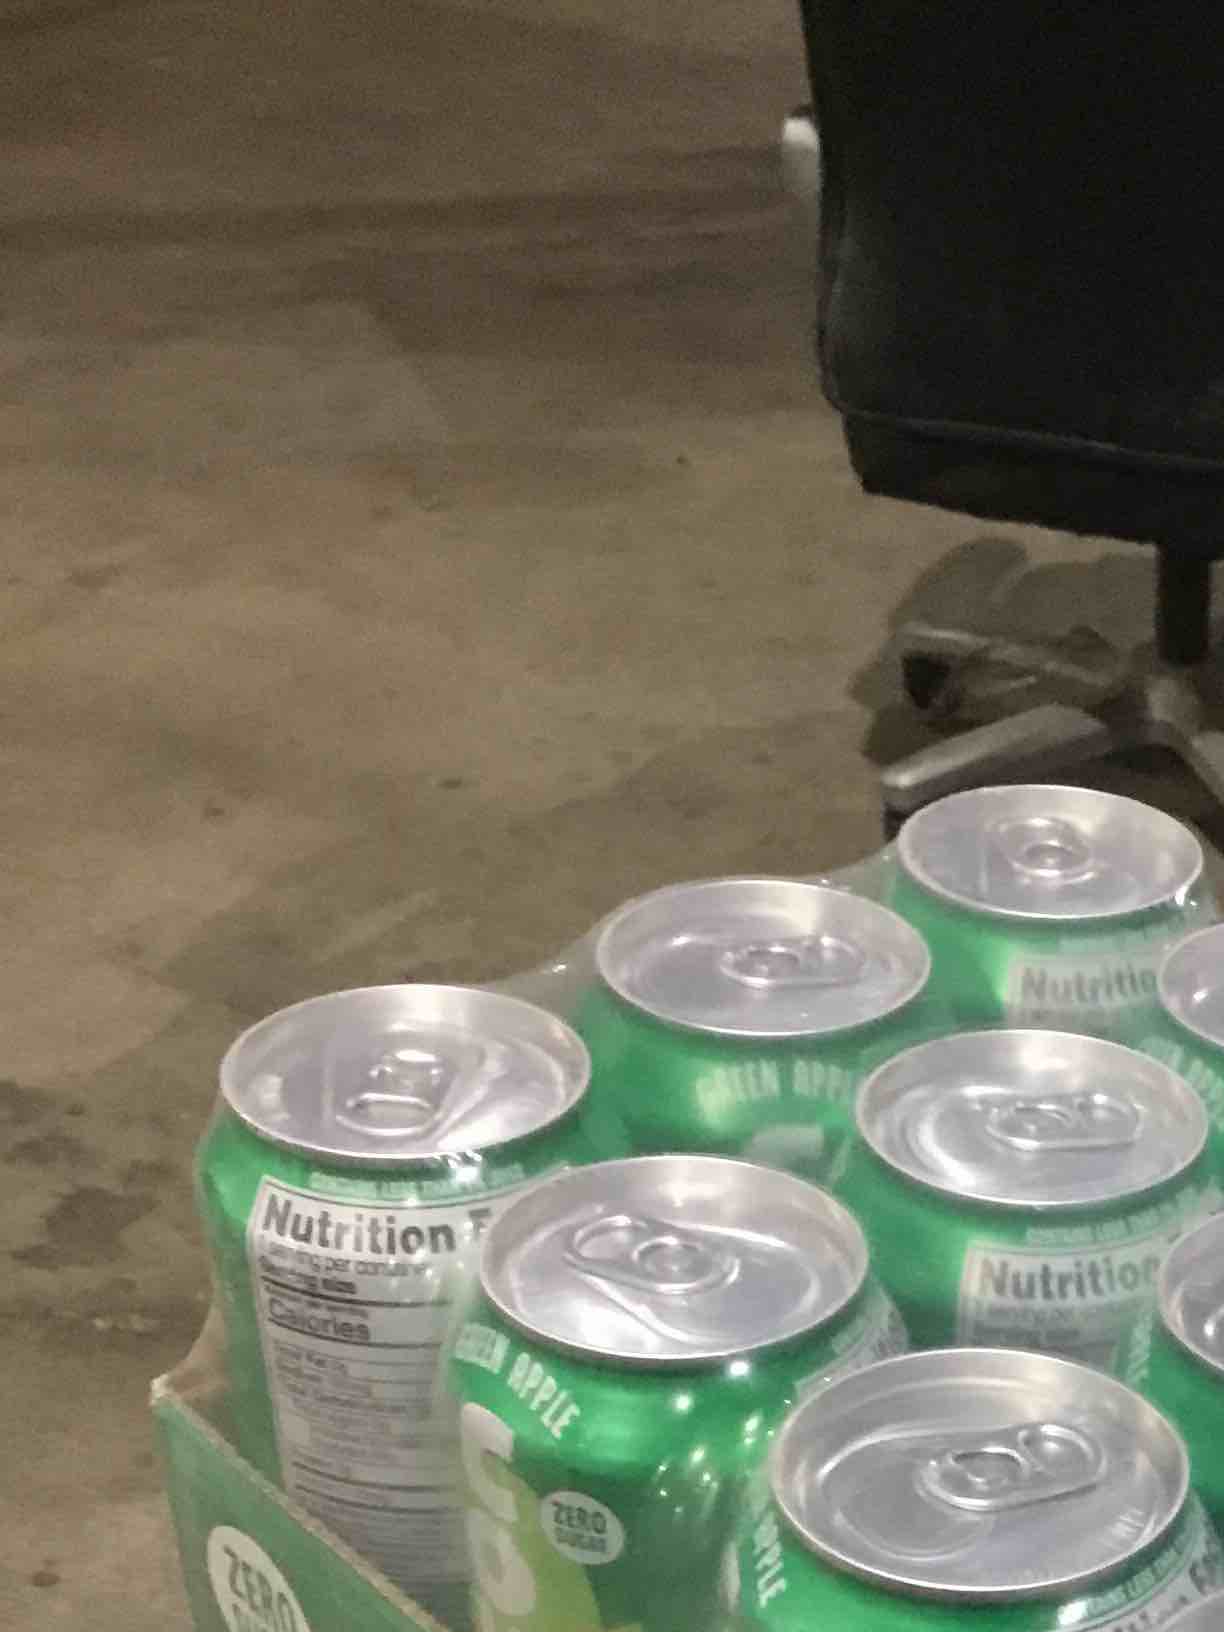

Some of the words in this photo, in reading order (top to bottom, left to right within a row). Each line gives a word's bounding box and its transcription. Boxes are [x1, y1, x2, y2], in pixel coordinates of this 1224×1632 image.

[263, 1192, 457, 1257] Nutrition
[506, 1352, 581, 1440] APPLE
[551, 1500, 608, 1535] ZERO
